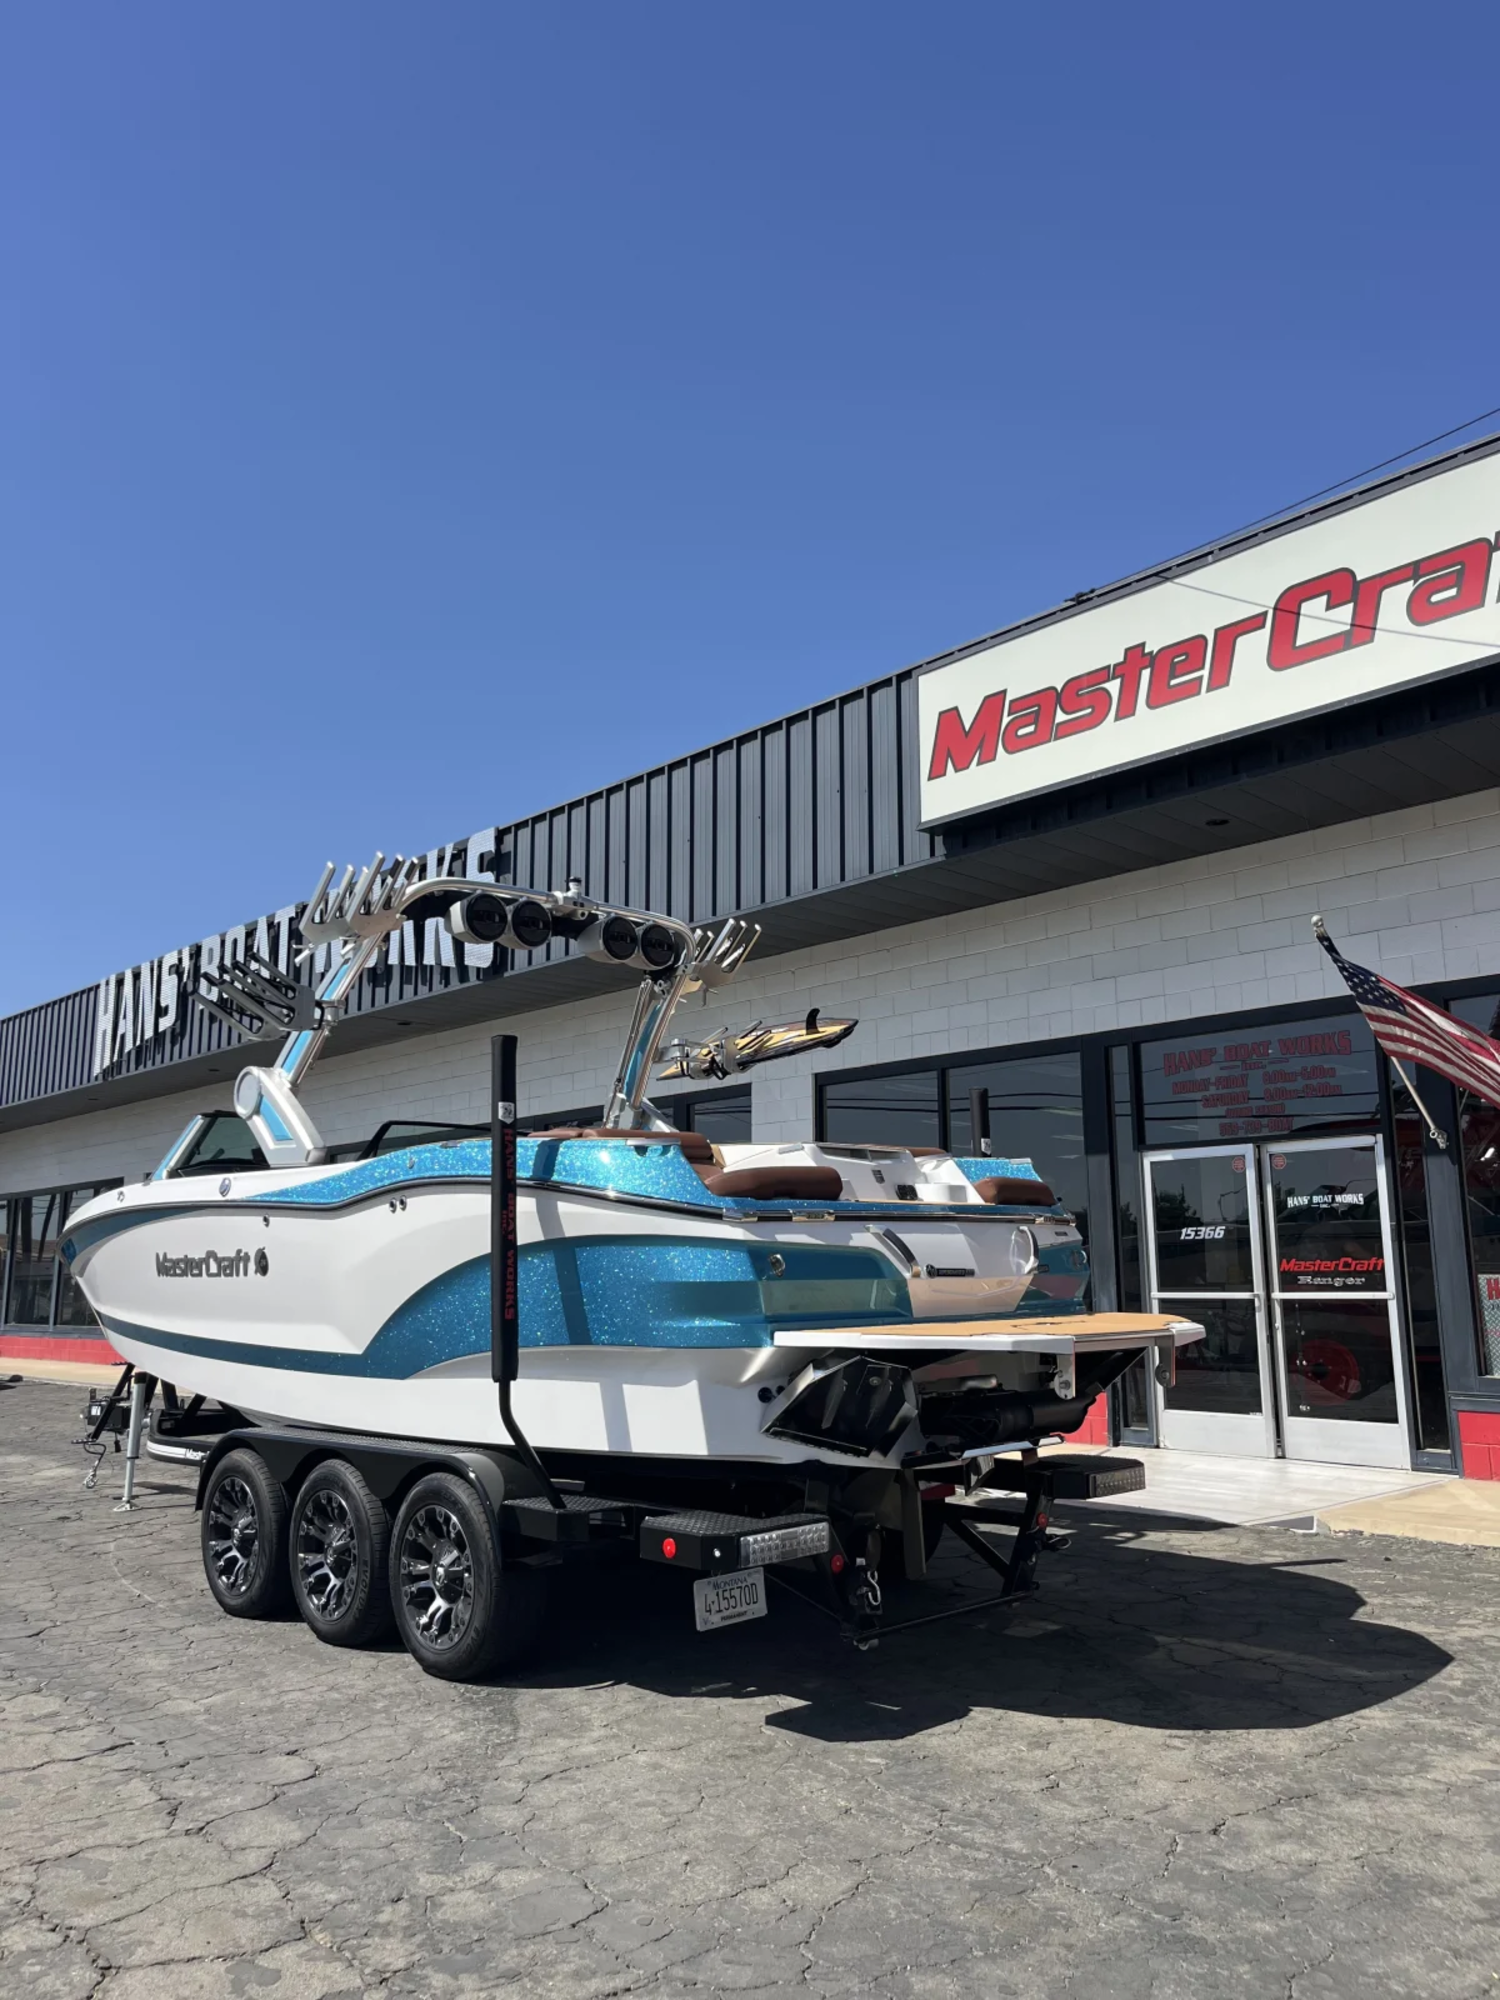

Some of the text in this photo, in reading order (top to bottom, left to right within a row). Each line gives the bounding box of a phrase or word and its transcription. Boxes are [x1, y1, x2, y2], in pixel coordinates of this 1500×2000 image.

[927, 531, 1500, 781] MasterCra
[94, 946, 190, 1077] HANS'
[1163, 1030, 1352, 1077] HANS' BOAT WORKS
[1201, 1090, 1250, 1108] SATURDAY
[1312, 1194, 1333, 1204] BOAT
[1334, 1193, 1364, 1205] WORKS
[507, 1193, 515, 1243] BOAT
[1180, 1226, 1226, 1240] 15366
[155, 1248, 251, 1278] MasterCraft
[1280, 1257, 1385, 1272] MasterCraft
[504, 1250, 515, 1320] WORKS
[1297, 1275, 1366, 1287] Ranger
[712, 1576, 748, 1590] MONTANA
